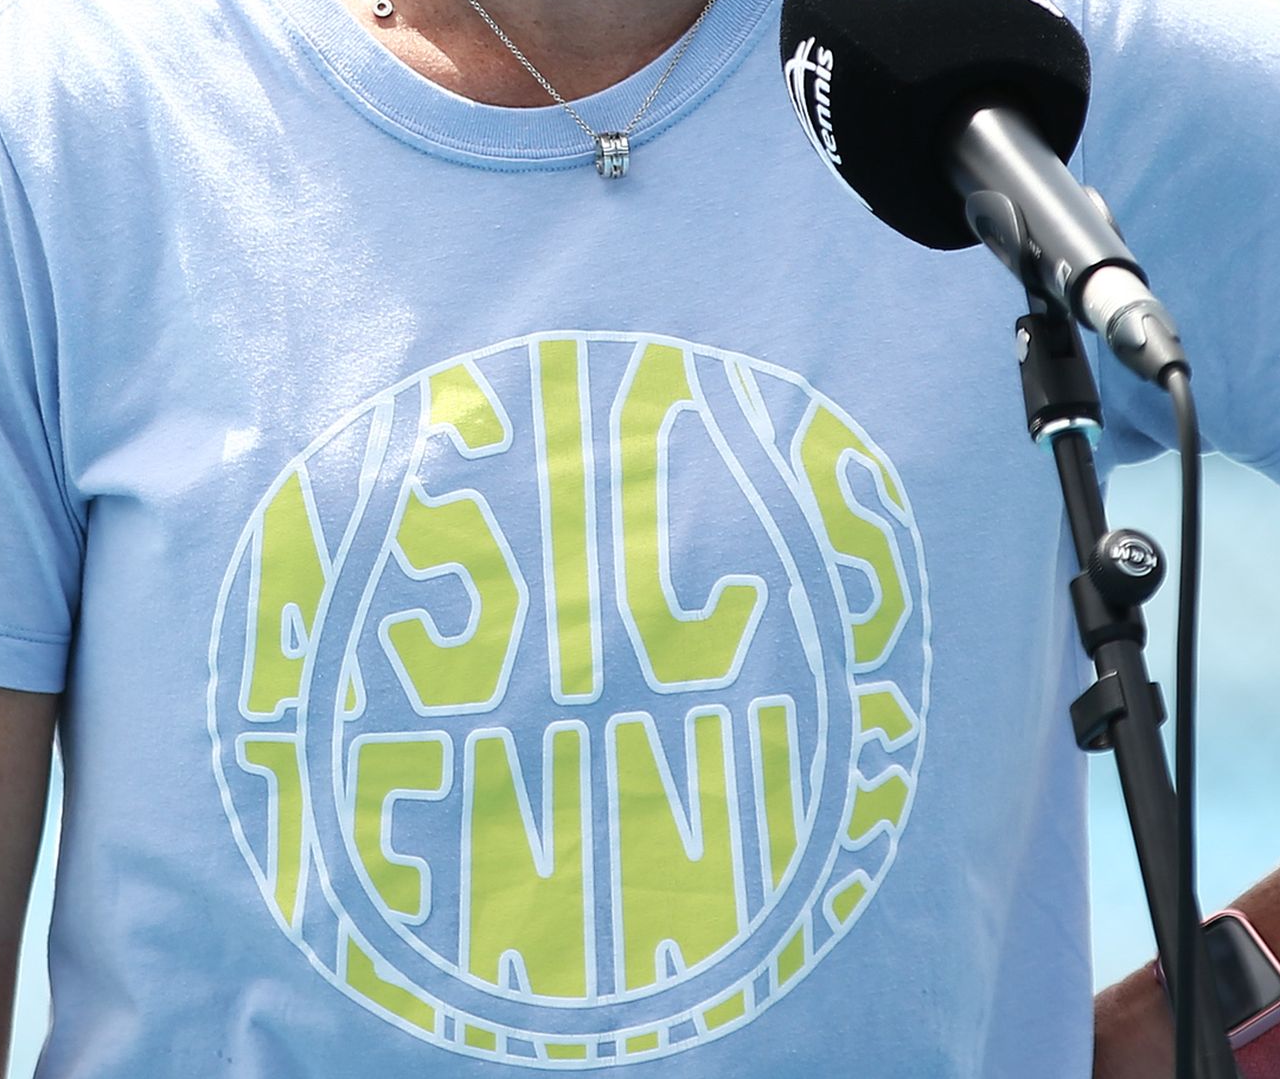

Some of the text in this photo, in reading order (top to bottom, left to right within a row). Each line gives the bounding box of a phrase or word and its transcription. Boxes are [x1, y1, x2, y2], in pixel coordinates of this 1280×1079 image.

[238, 335, 916, 722] ASICS
[1110, 545, 1158, 568] K&M
[235, 682, 918, 1060] TENNIS
